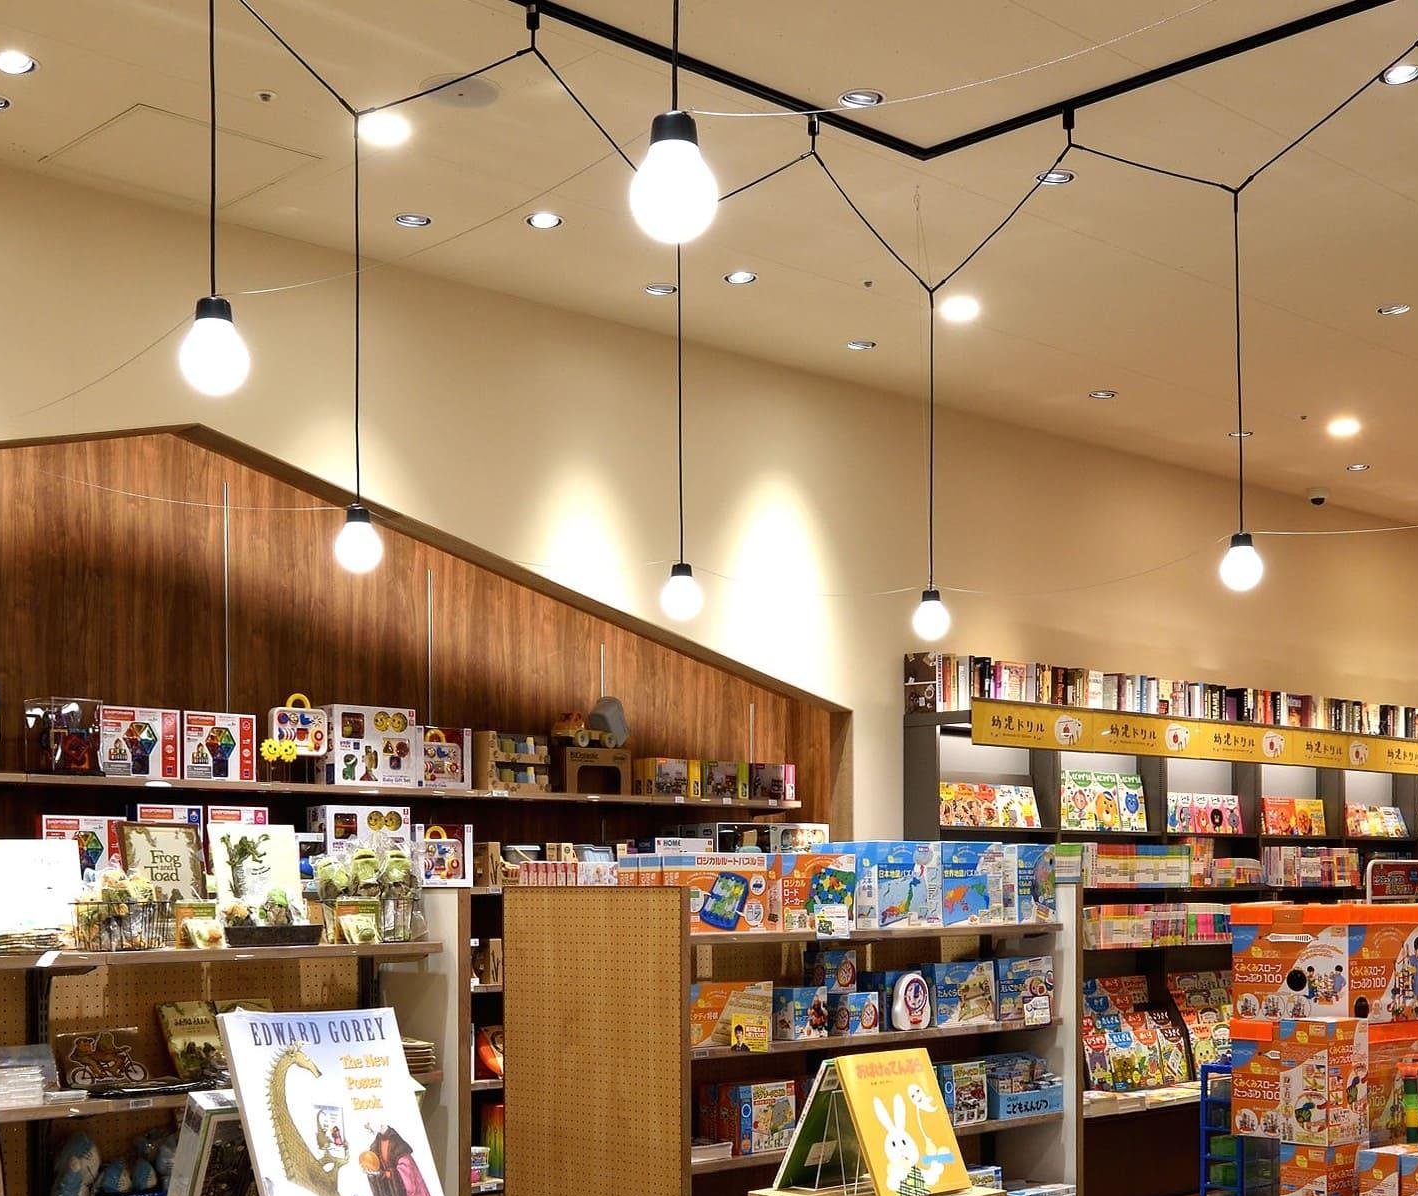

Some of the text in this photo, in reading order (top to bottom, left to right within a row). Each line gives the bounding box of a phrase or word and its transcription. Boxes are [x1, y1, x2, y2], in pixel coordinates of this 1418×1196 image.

[990, 714, 1046, 733] 幼児ドリル
[1109, 723, 1157, 740] 幼児ドリル
[1213, 732, 1255, 748] 幼児ドリル
[1305, 740, 1343, 756] 幼児ドリル
[151, 849, 182, 869] Frog
[160, 863, 173, 871] and
[696, 857, 757, 866] ロジカルルートパズル
[148, 866, 181, 882] Toad
[783, 880, 806, 888] ロジカル
[783, 889, 800, 897] ロード
[783, 898, 805, 906] メーカー
[1233, 963, 1283, 973] くみくみスロープ
[1233, 973, 1283, 984] たっぷり100
[250, 1016, 386, 1046] EDWARD GOREY
[339, 1054, 391, 1069] The New
[346, 1075, 383, 1092] Poster
[352, 1095, 383, 1111] Book
[1005, 1098, 1049, 1116] こどもえんぴつ
